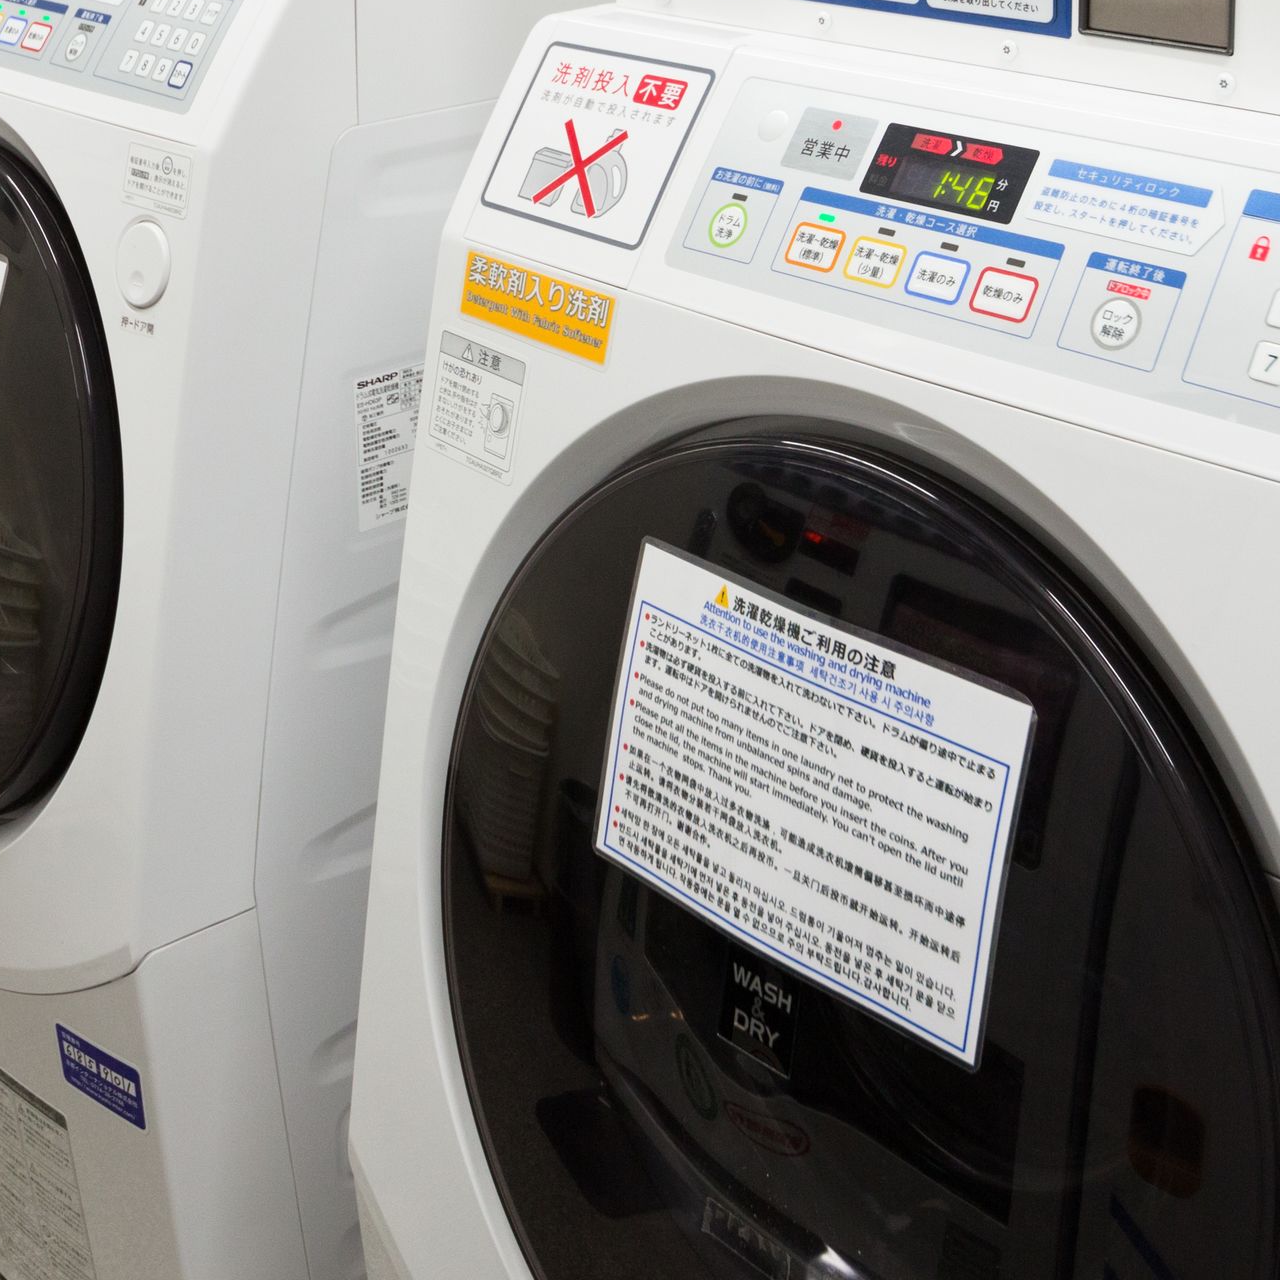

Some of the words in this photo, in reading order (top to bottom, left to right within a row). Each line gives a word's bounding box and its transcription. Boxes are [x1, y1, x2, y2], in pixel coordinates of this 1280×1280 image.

[552, 62, 629, 97] 洗剤投入
[639, 77, 682, 108] 不要
[801, 138, 850, 162] 営業中
[933, 171, 995, 210] 1:46
[1076, 166, 1181, 200] セキュリティロック
[918, 268, 955, 286] 洗濯のみ
[1104, 256, 1166, 283] 運転終了後
[467, 290, 509, 315] Detergent
[468, 255, 610, 328] 柔軟剤入り洗剤
[983, 285, 1022, 304] 乾燥のみ
[478, 347, 502, 371] 注意
[1265, 354, 1278, 372] 7
[704, 601, 740, 624] Attention
[743, 619, 750, 630] to
[753, 626, 767, 638] use
[770, 632, 784, 645] the
[787, 642, 825, 665] washing
[828, 660, 846, 673] and
[849, 668, 882, 689] drying
[885, 683, 930, 707] machine
[733, 596, 895, 679] 洗濯乾燥機ご利用の注意
[734, 961, 794, 1015] WASH
[733, 1008, 779, 1049] DRY
